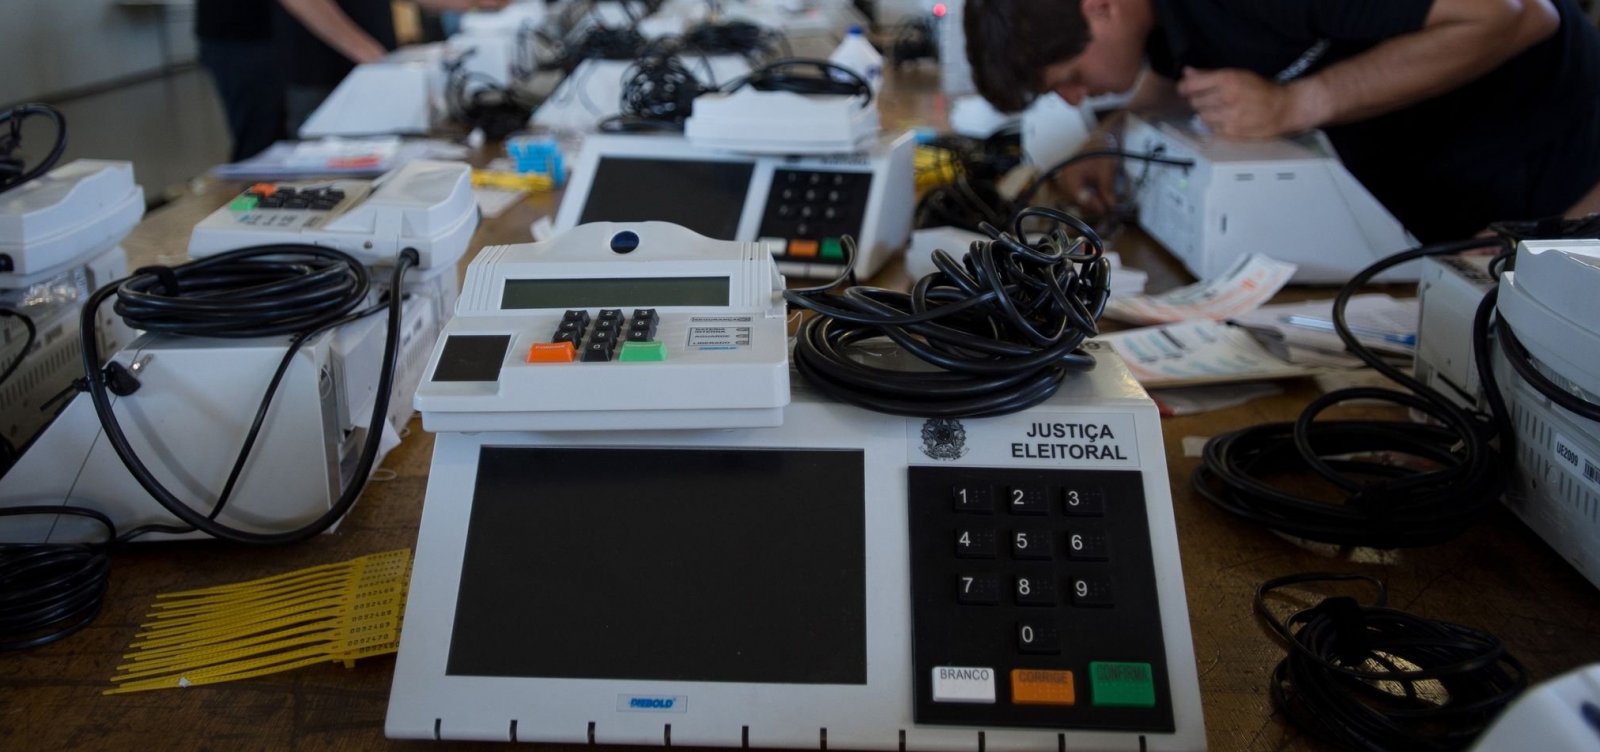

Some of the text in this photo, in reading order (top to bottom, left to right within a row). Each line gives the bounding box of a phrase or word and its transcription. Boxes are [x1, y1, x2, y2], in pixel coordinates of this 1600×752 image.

[1026, 422, 1115, 443] JUSTIÇA
[1011, 442, 1128, 460] ELEITORAL
[1556, 441, 1579, 467] UE2009
[959, 488, 1080, 506] 1 2 3
[959, 531, 1083, 551] 4 5 6
[962, 577, 1088, 597] 7 8 9
[1021, 625, 1034, 643] 0
[939, 668, 990, 681] BRANCO
[1018, 671, 1069, 685] CORRIGE
